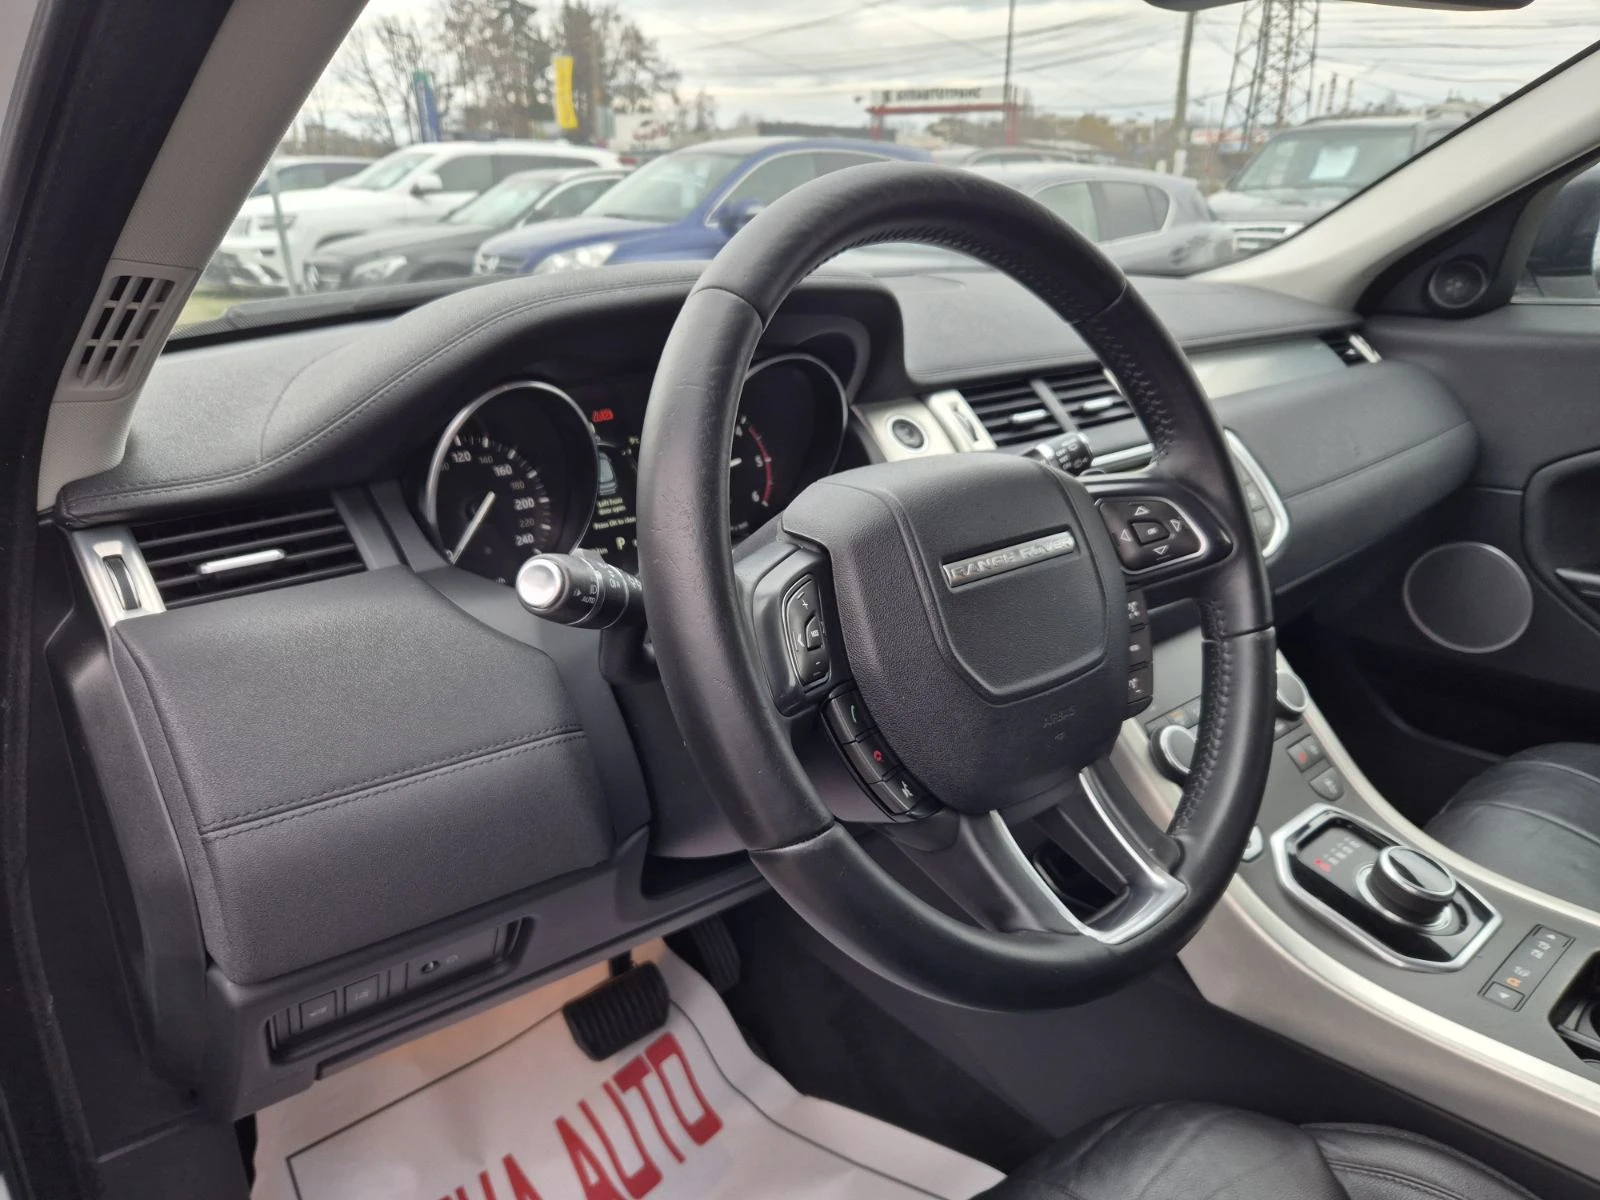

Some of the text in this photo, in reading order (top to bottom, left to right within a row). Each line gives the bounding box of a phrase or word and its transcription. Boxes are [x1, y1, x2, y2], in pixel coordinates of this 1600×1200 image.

[452, 451, 471, 463] 120
[480, 456, 494, 464] 140
[494, 463, 513, 477] 160
[511, 481, 525, 490] 180
[514, 497, 535, 511] 200
[520, 519, 535, 528] 220
[515, 533, 535, 546] 240
[616, 537, 626, 550] P
[950, 536, 1074, 579] RANGE ROVER
[555, 1031, 723, 1200] AUTO
